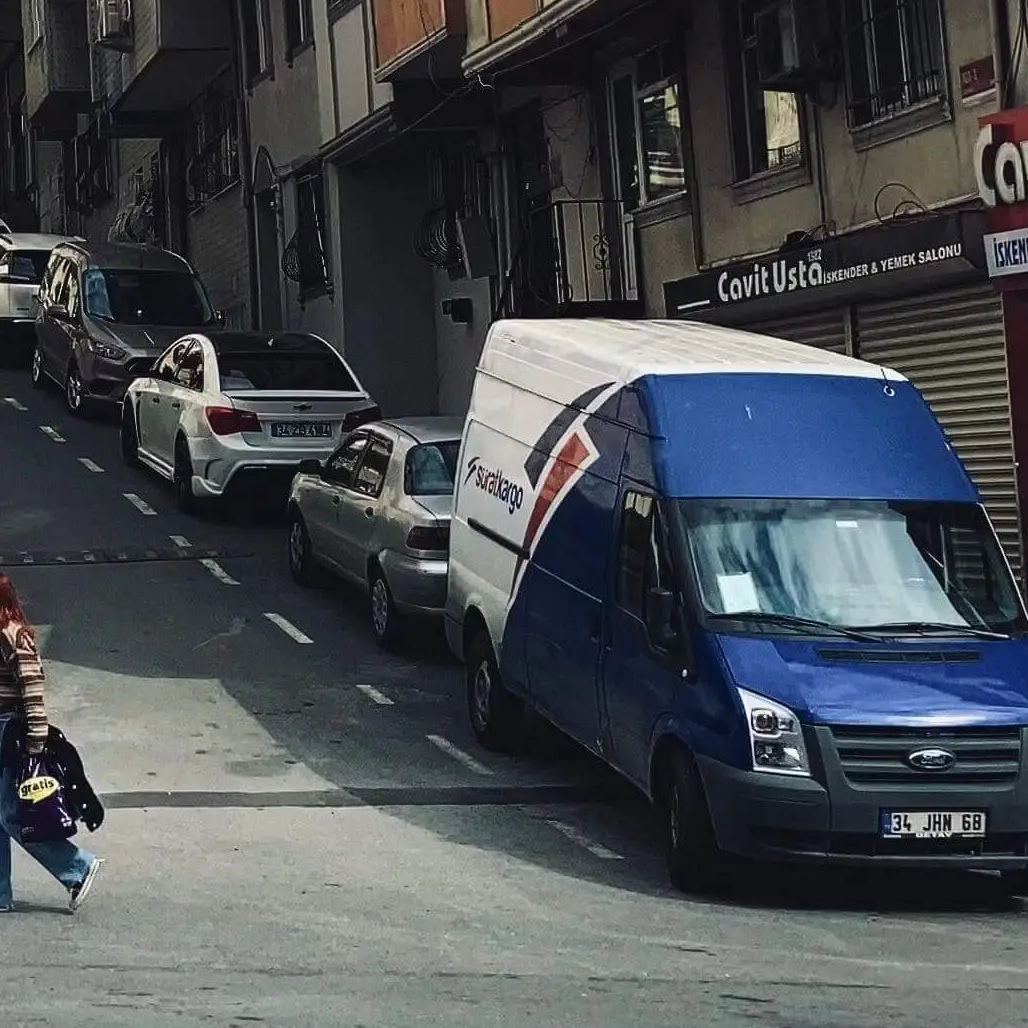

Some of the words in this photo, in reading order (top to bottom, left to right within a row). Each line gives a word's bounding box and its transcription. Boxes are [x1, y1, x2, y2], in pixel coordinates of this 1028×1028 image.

[871, 262, 878, 274] &
[880, 255, 917, 272] YEMEK
[918, 243, 962, 262] SALONU
[993, 237, 1028, 268] İSKEN
[717, 262, 769, 302] Cavit
[772, 258, 823, 293] Usta
[22, 778, 55, 797] gratis
[892, 813, 912, 832] 34
[922, 813, 952, 832] JHN
[962, 813, 982, 832] 68
